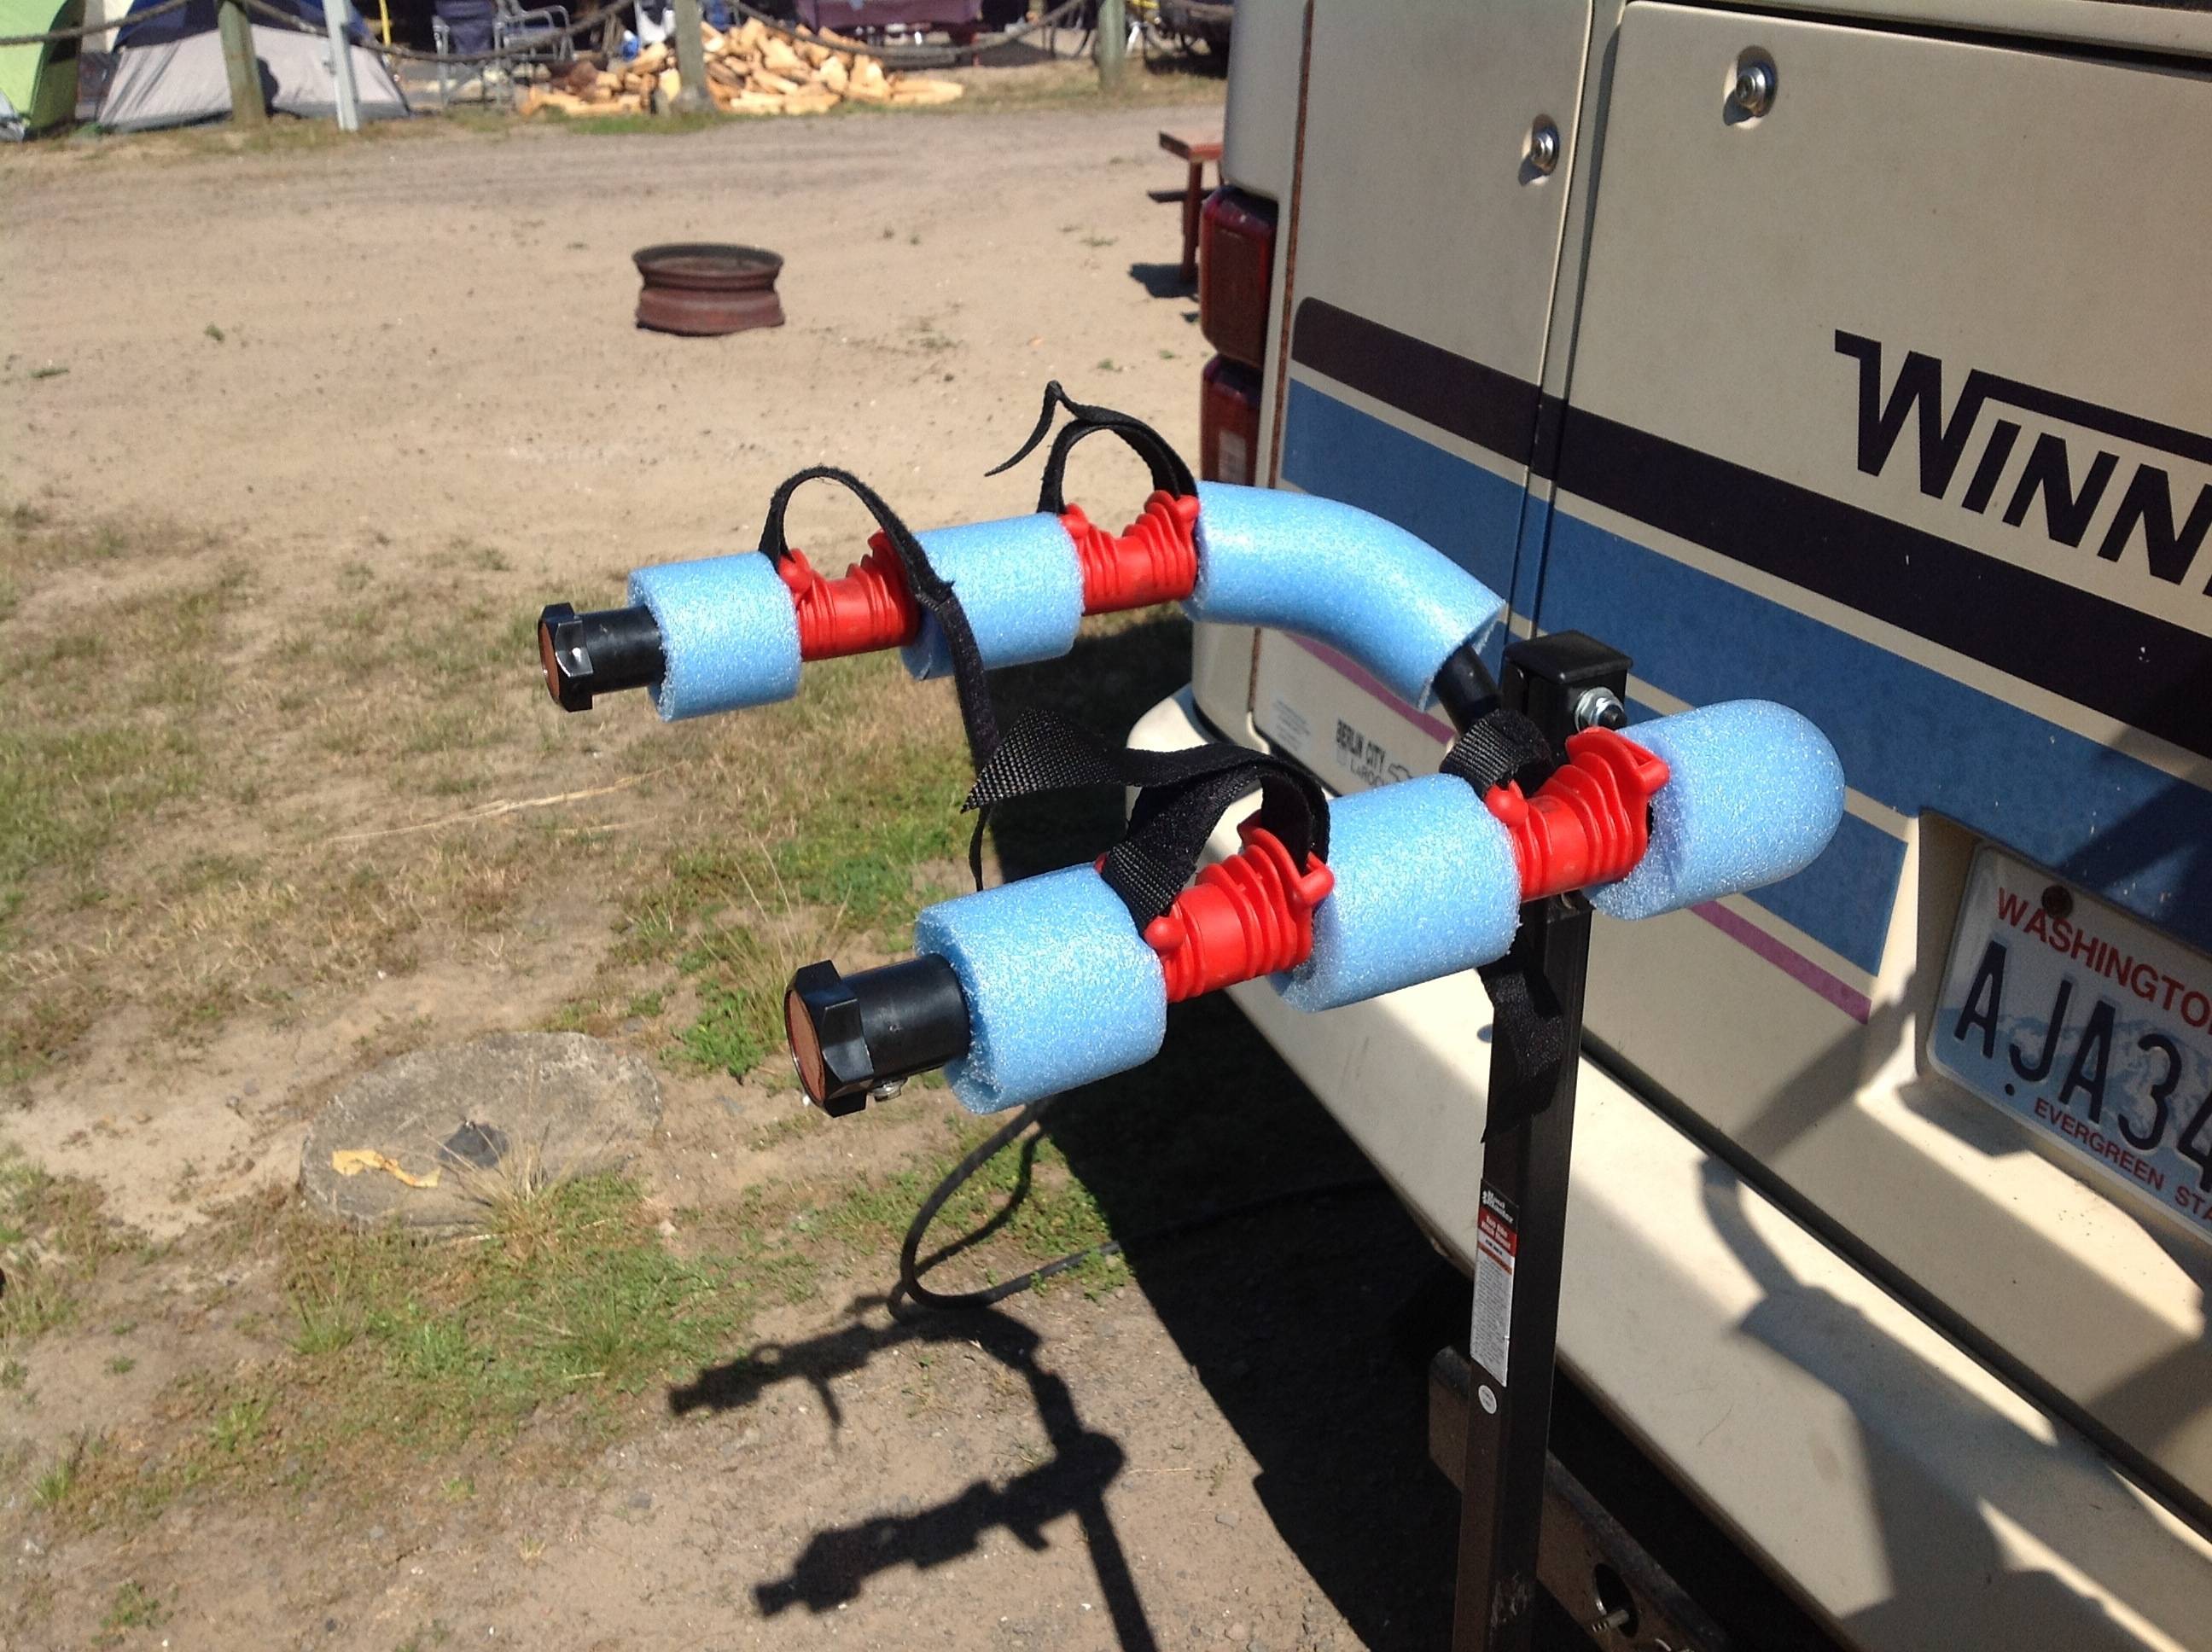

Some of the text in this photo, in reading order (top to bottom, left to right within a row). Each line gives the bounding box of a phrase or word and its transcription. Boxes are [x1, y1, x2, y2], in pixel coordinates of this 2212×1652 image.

[1835, 329, 2212, 597] WINN
[1336, 718, 1363, 759] BERLIN
[1366, 741, 1386, 774] CITY
[1998, 887, 2212, 1035] WASHINGTO
[2034, 1097, 2165, 1191] EVERGREEN
